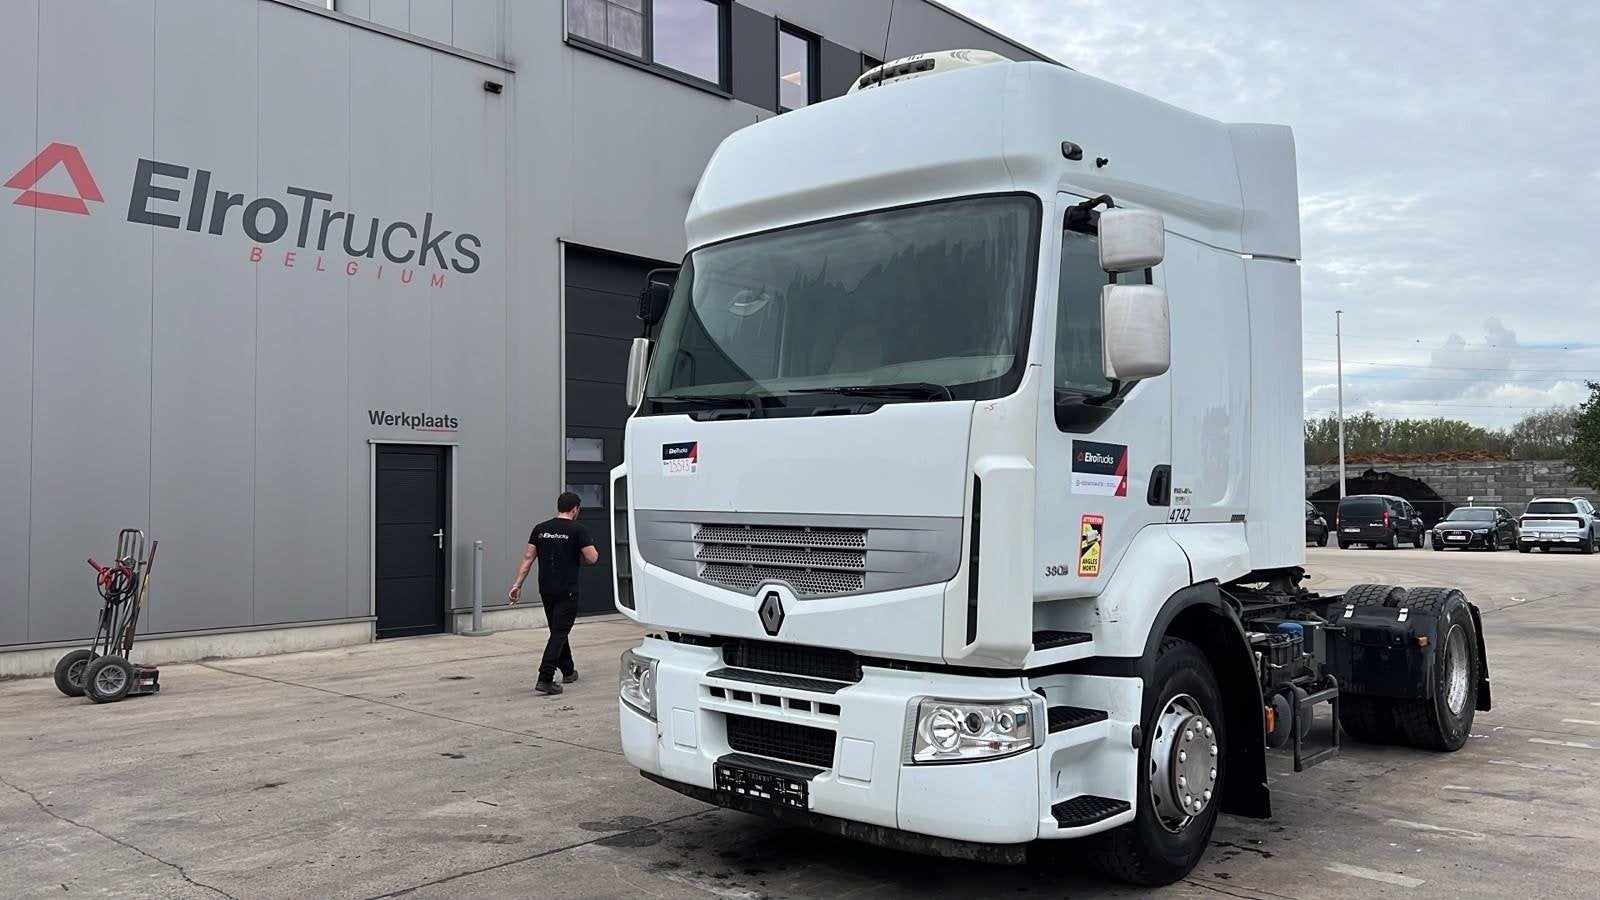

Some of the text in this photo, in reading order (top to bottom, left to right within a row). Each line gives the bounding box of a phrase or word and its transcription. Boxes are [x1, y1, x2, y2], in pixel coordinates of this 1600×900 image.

[126, 157, 481, 274] ElroTrucks
[250, 247, 445, 288] BELGIUM
[368, 410, 458, 429] Werkplaats
[1084, 452, 1114, 465] ElroTrucks
[1169, 508, 1191, 522] 4742
[1045, 565, 1063, 577] 380
